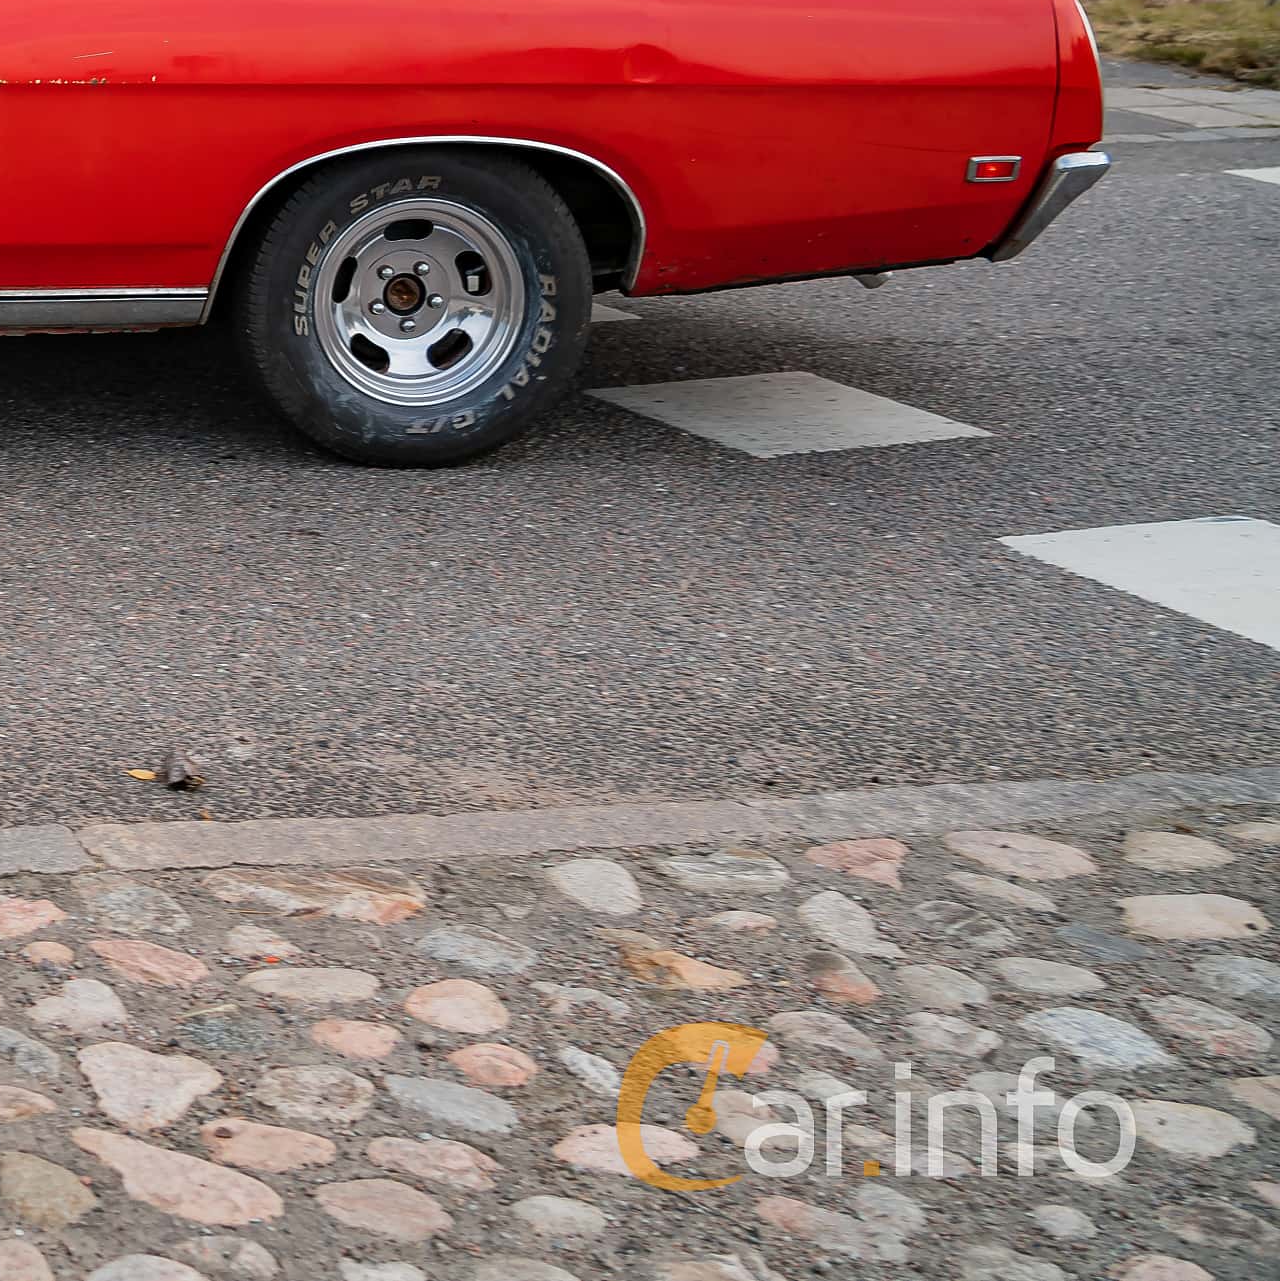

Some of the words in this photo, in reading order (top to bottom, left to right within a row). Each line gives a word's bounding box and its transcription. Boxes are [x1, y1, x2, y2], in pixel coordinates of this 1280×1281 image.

[294, 220, 338, 337] SUPER
[350, 176, 442, 215] STAR
[496, 274, 557, 401] RADIAL
